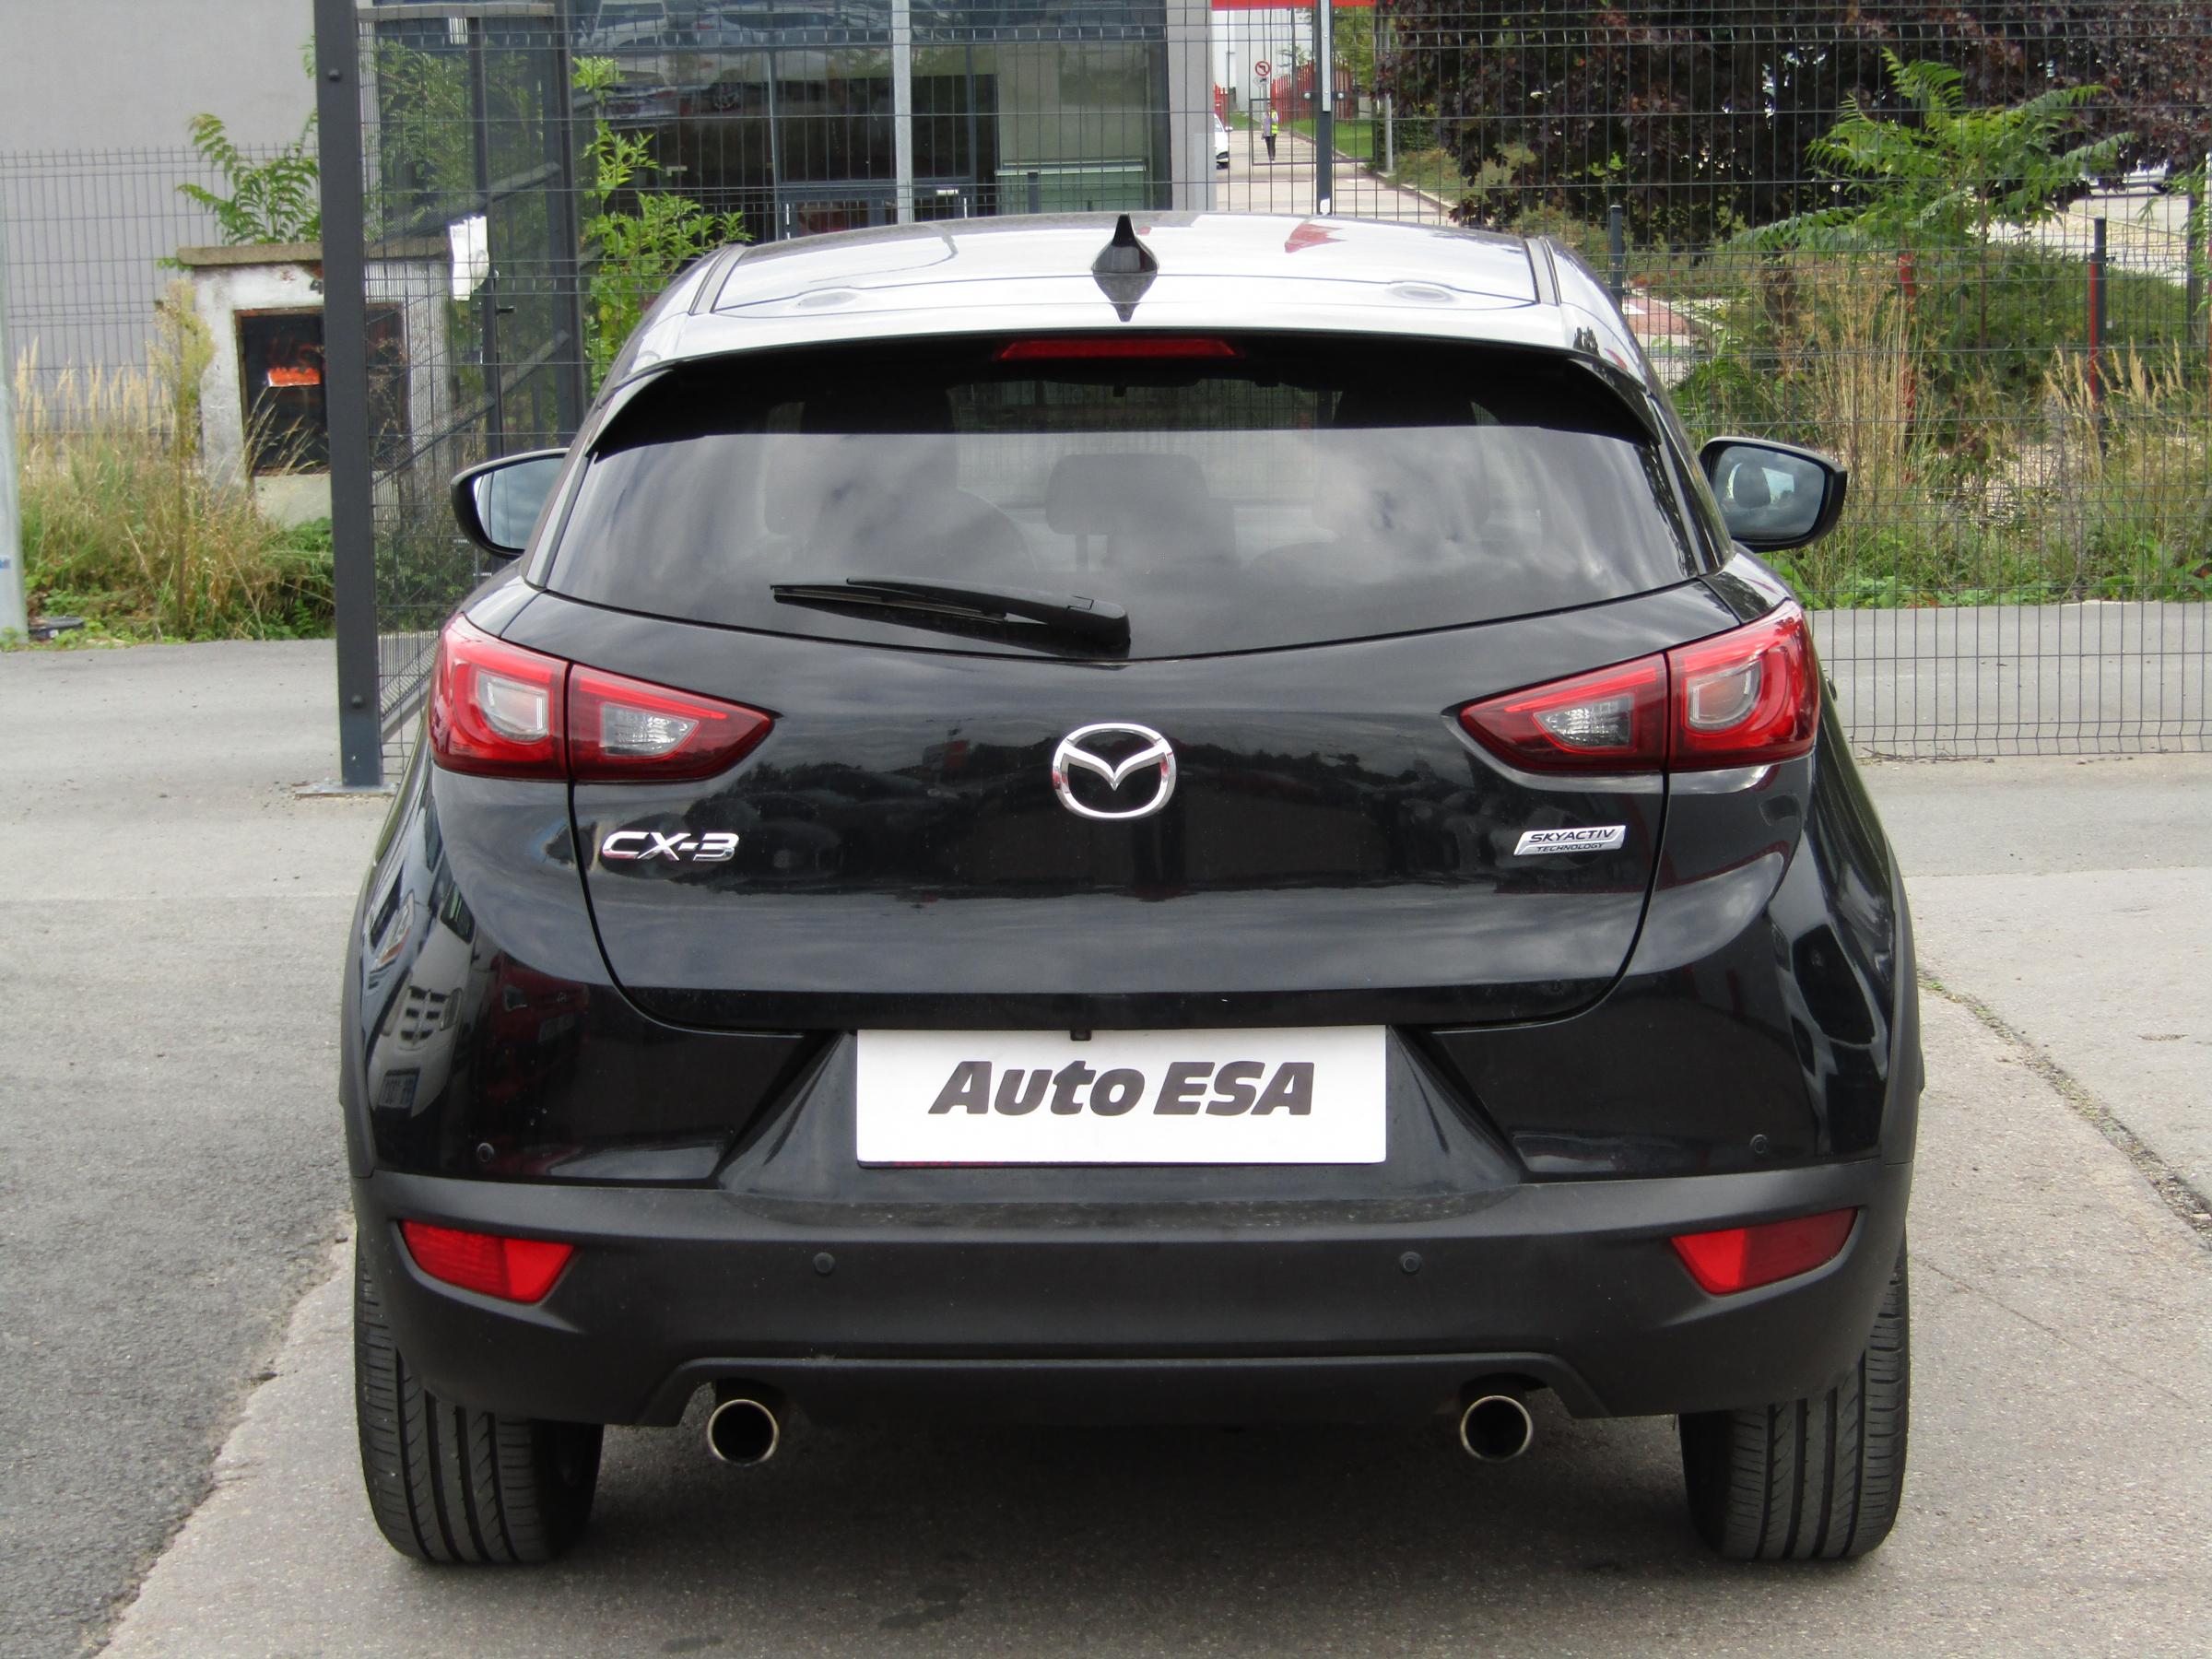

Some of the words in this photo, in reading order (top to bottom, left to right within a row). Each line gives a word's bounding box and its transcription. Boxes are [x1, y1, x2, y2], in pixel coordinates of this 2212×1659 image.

[602, 831, 739, 862] CX-3
[1529, 830, 1616, 843] SKYACTIV
[1536, 842, 1606, 853] TECHNOLOGY
[928, 1061, 1145, 1116] Auto
[1153, 1061, 1314, 1115] ESA
